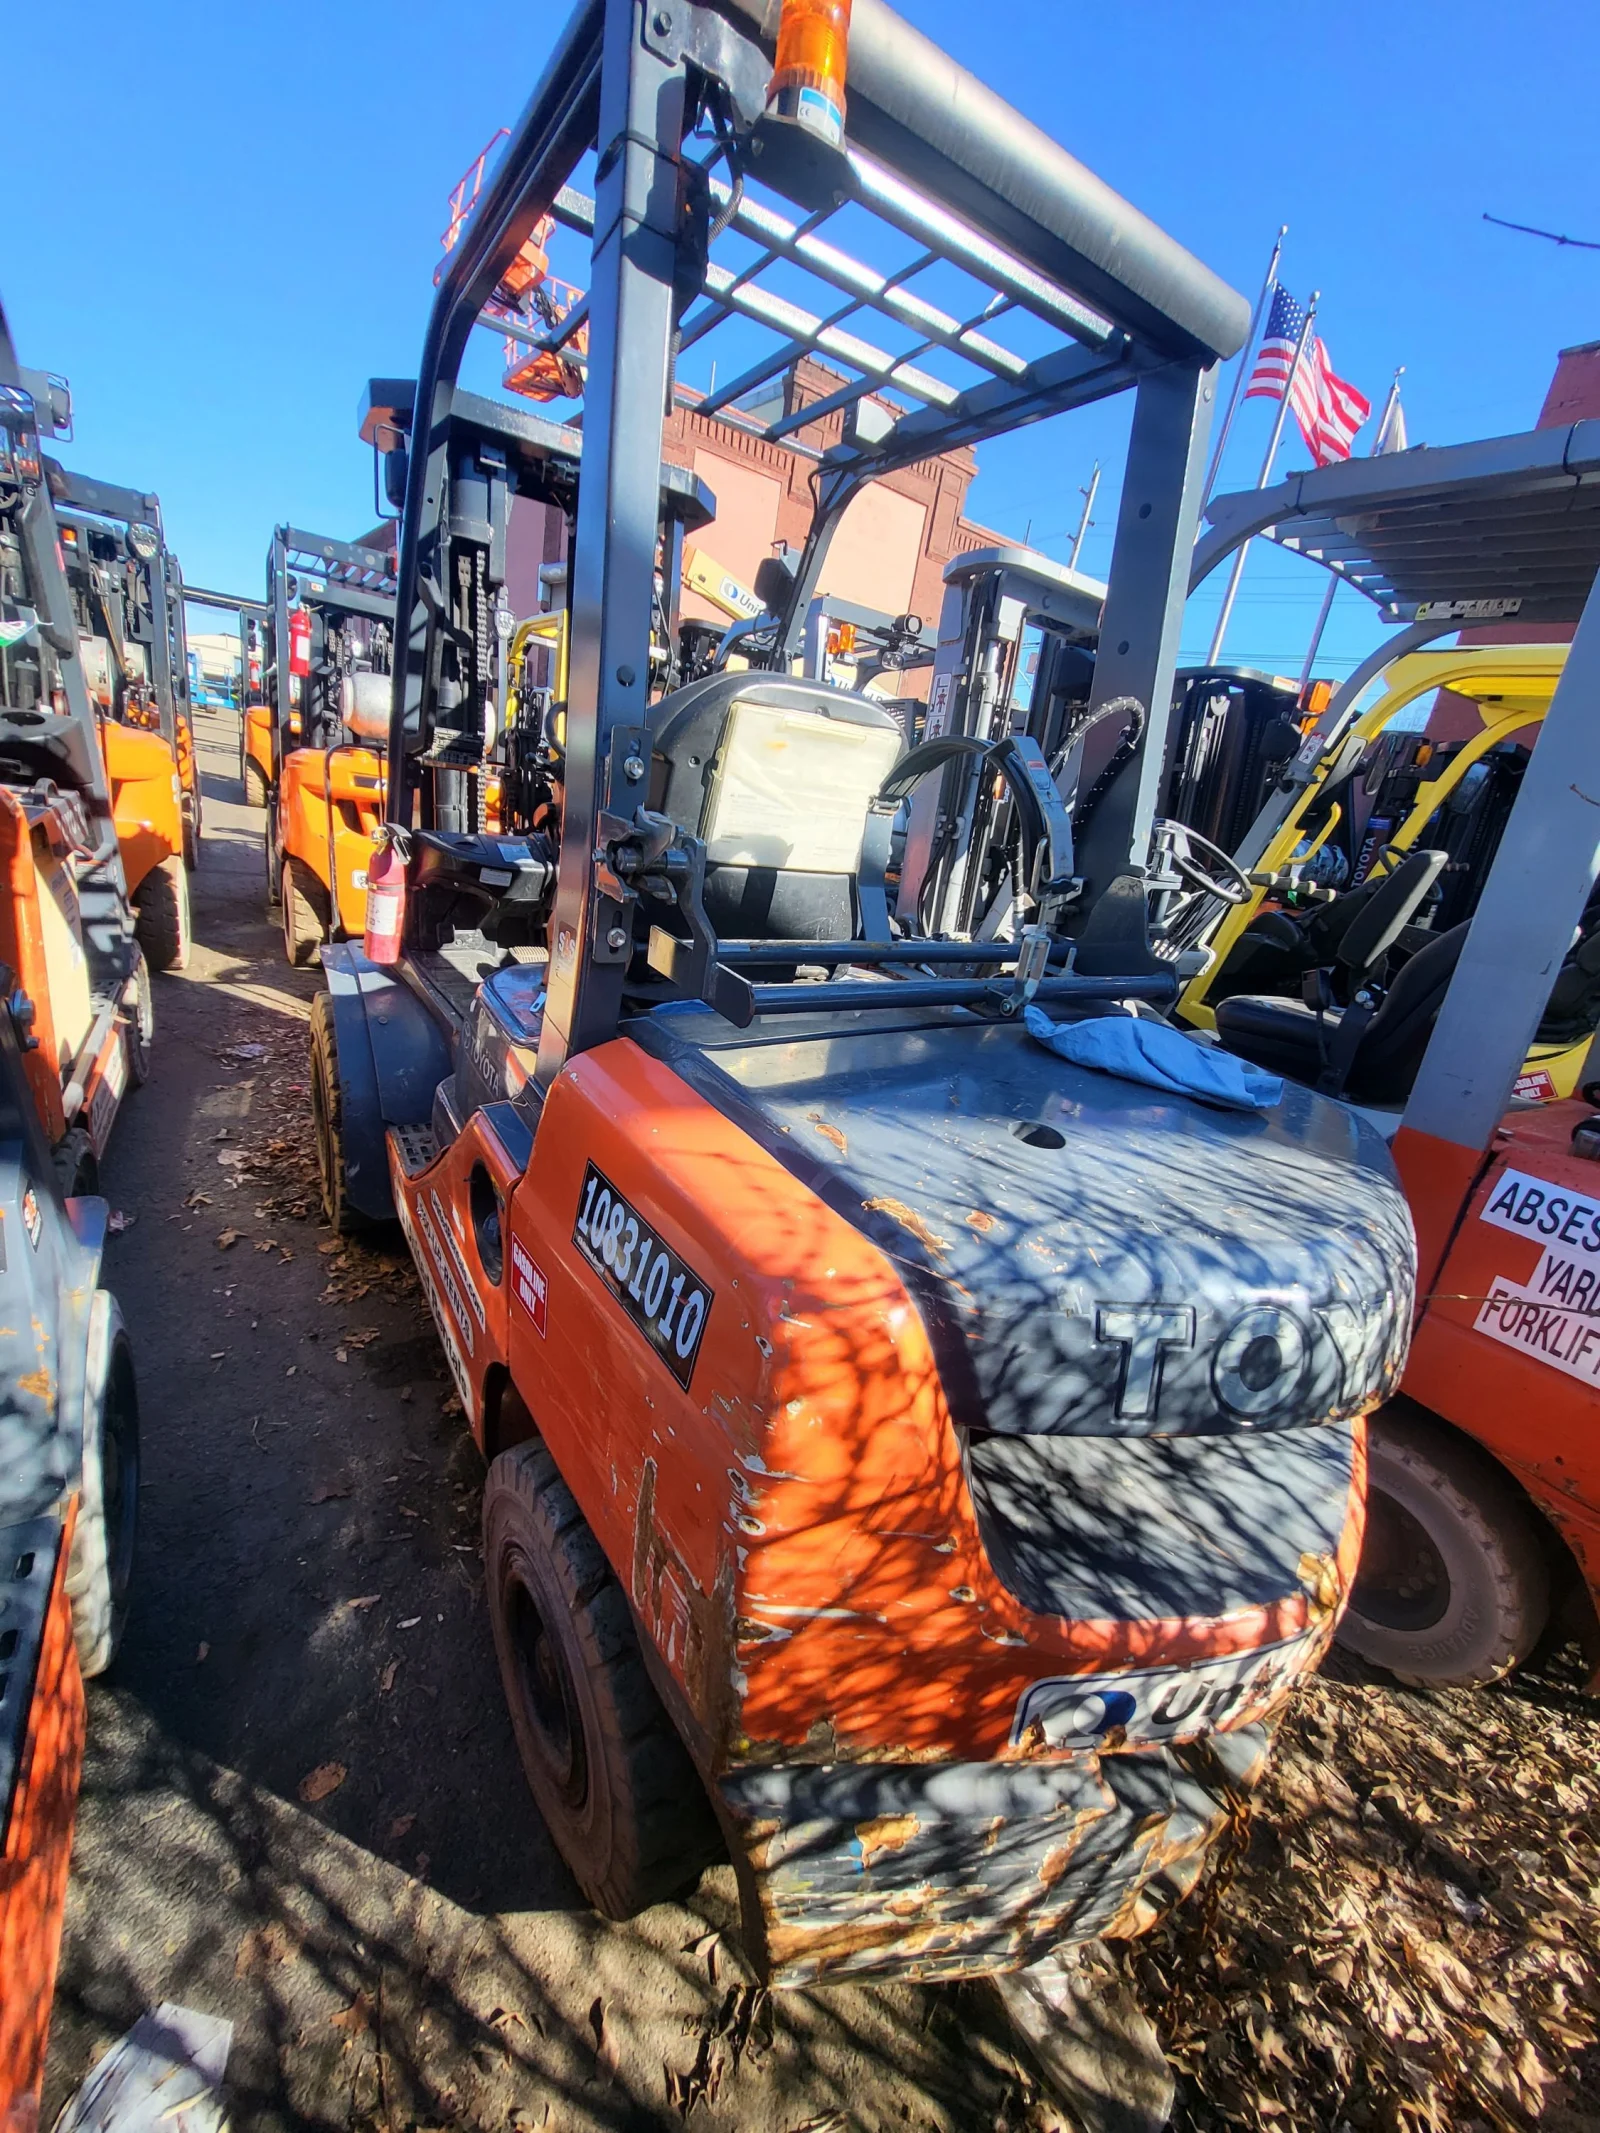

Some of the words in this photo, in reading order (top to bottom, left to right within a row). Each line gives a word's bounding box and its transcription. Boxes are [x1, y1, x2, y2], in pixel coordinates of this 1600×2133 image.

[1351, 836, 1377, 888] TOYOTA
[513, 1242, 546, 1304] GASOLINE
[519, 1276, 537, 1315] ONLY
[578, 1176, 705, 1359] 10831010
